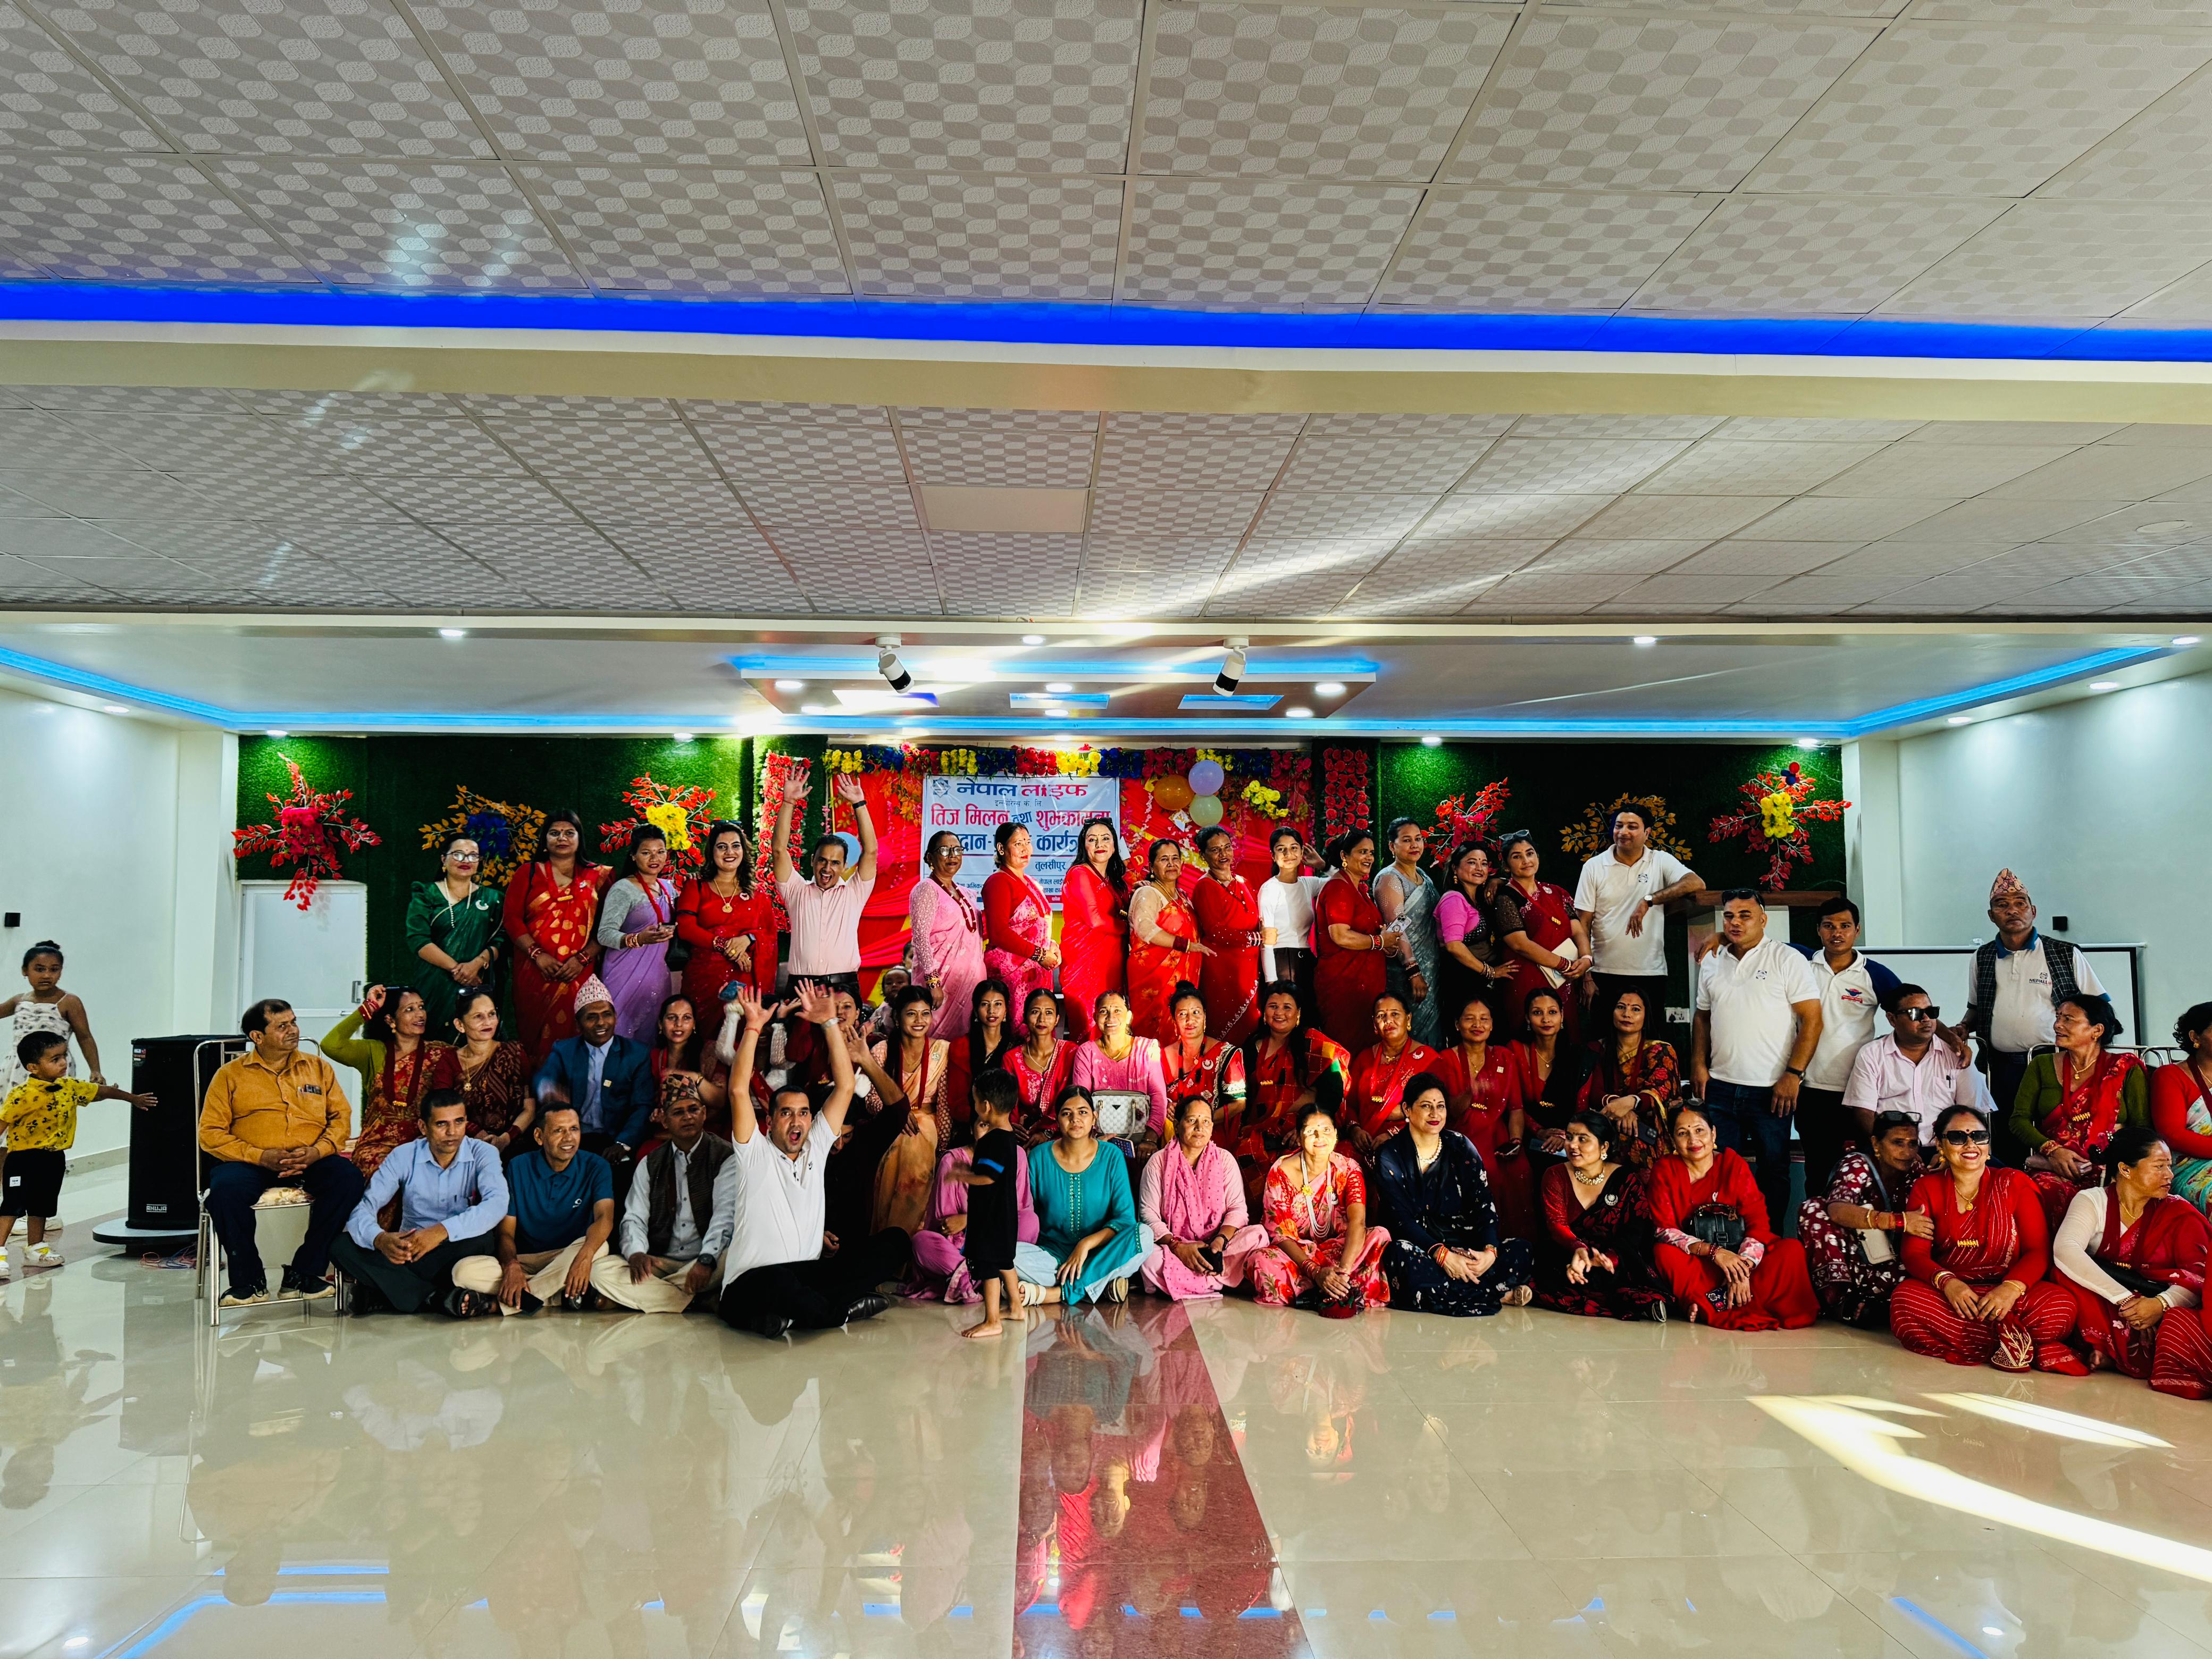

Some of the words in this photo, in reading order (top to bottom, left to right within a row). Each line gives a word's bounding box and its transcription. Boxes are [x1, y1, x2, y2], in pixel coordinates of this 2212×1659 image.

[957, 777, 1017, 797] नेपाल
[1021, 784, 1088, 800] लाइफ
[931, 803, 960, 826] तिज
[966, 803, 1010, 826] मिलन
[1011, 811, 1033, 823] तथा
[1035, 859, 1066, 871] तुलसीपुर
